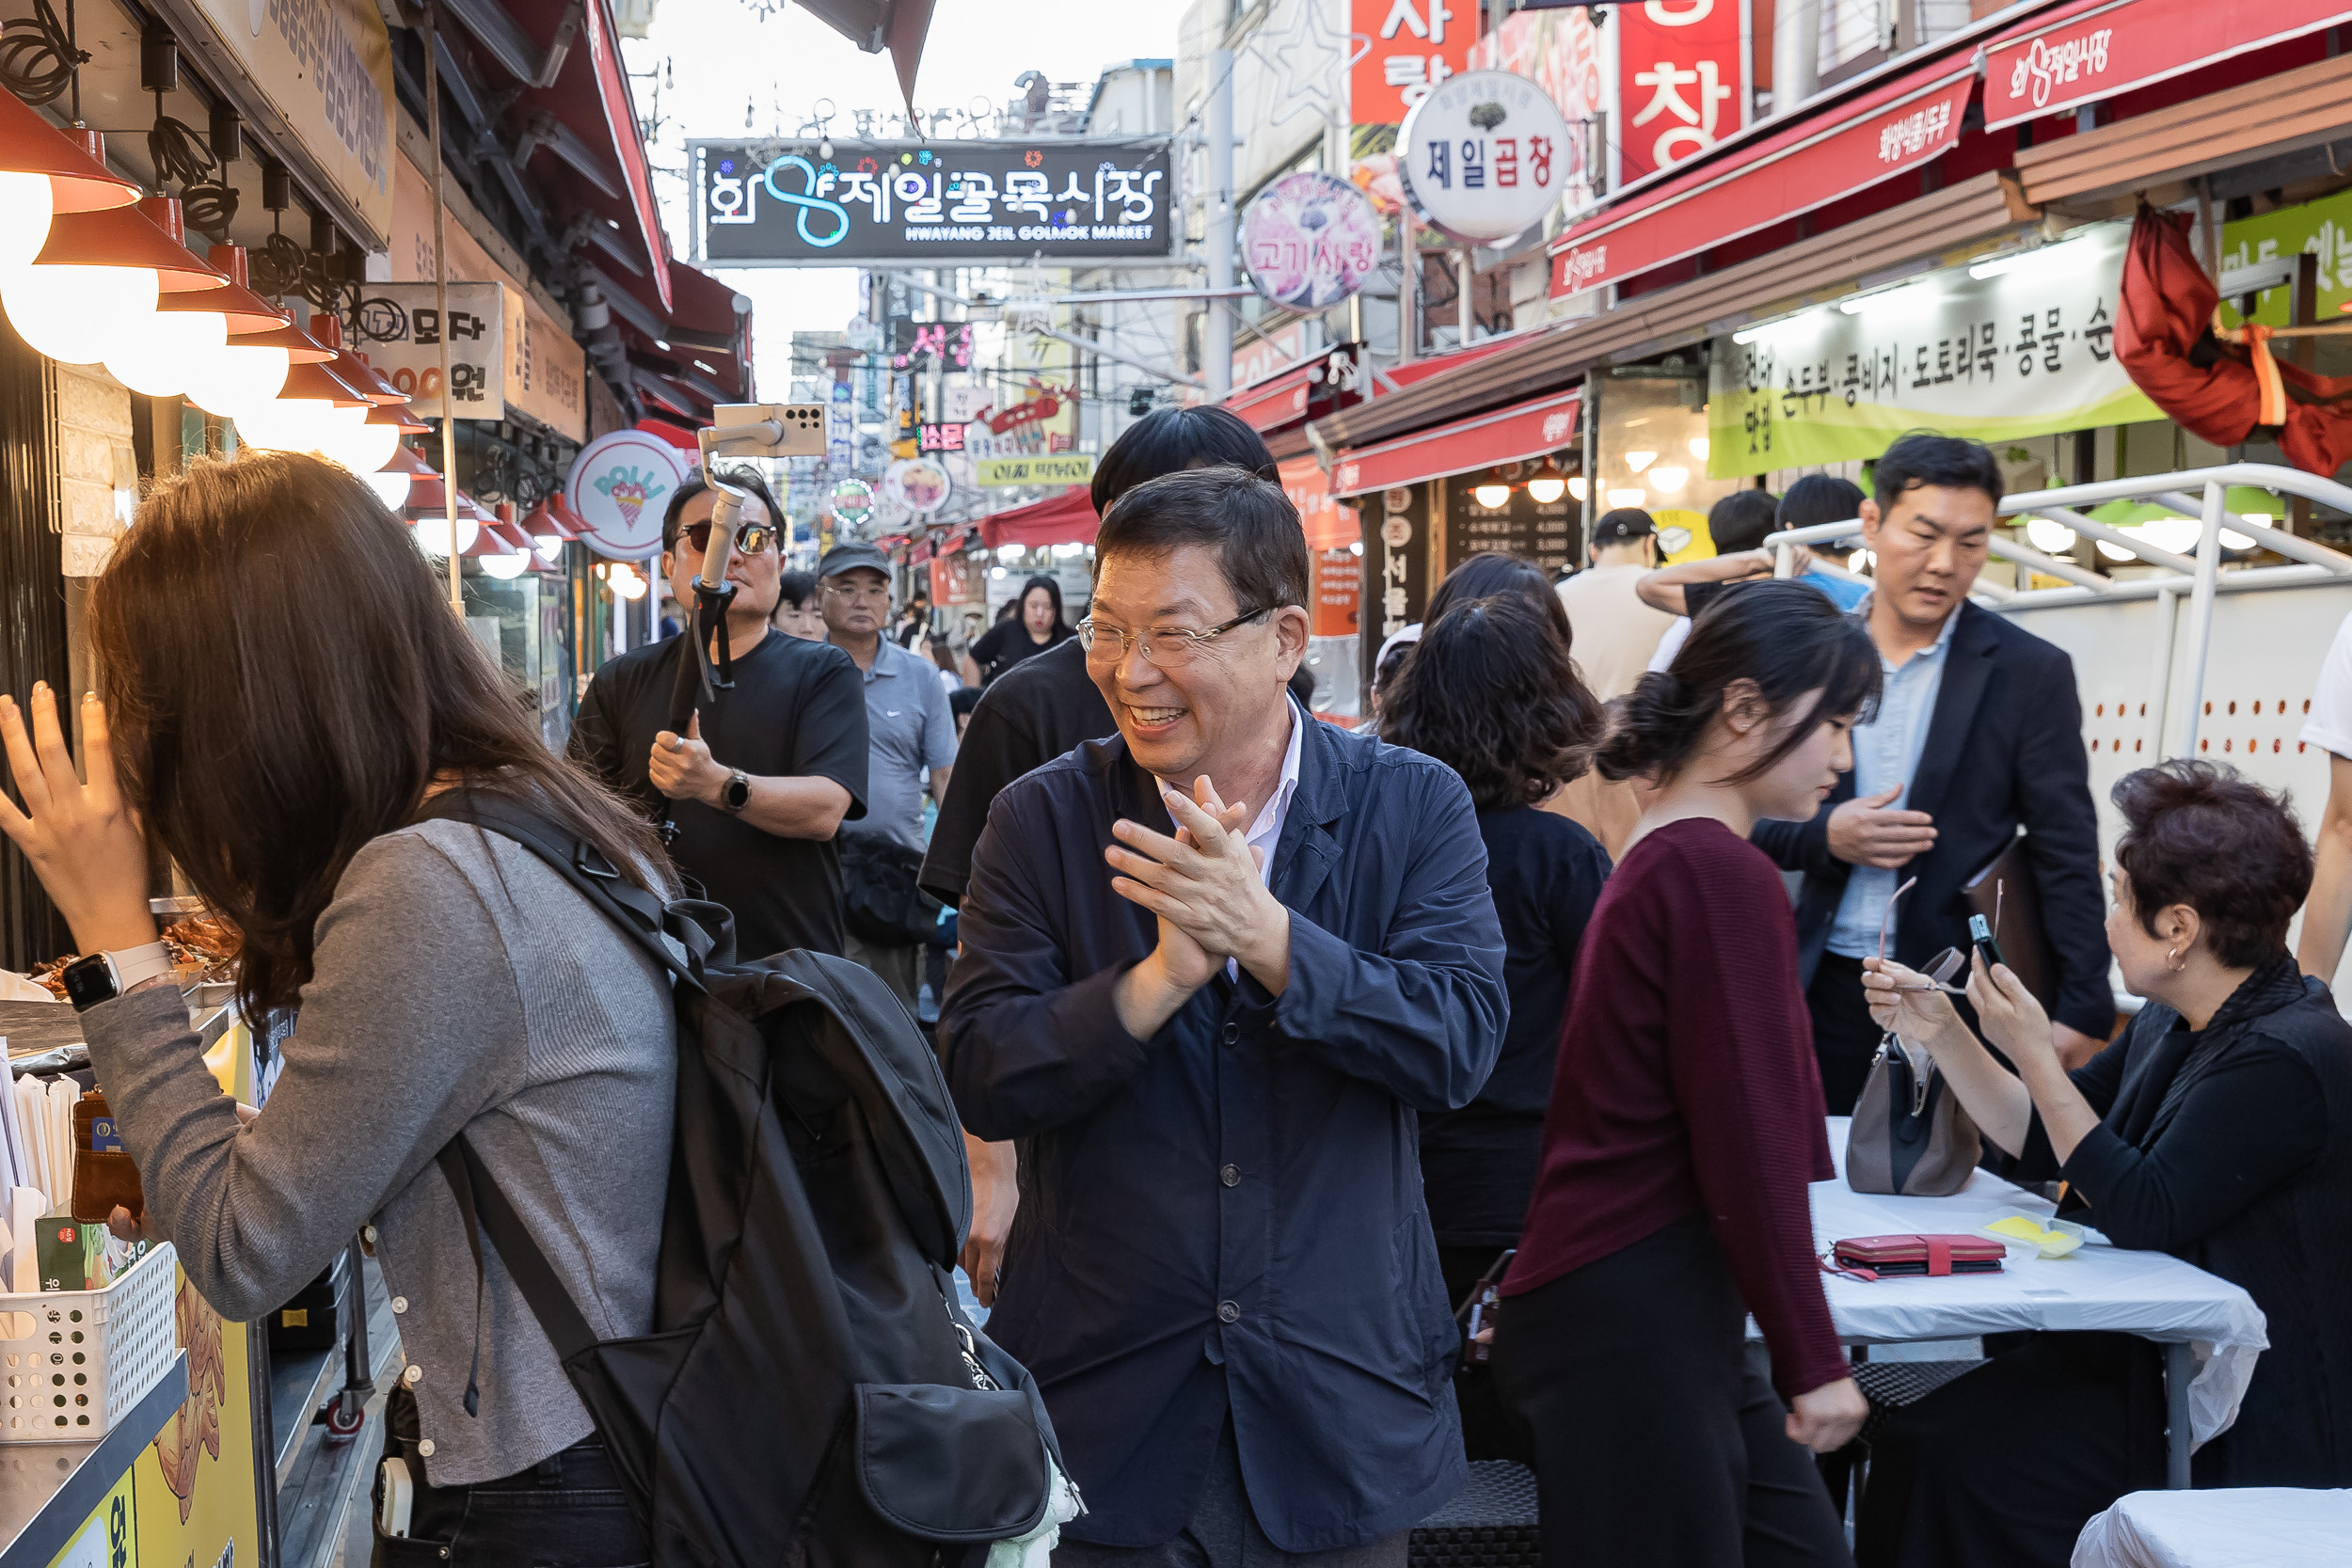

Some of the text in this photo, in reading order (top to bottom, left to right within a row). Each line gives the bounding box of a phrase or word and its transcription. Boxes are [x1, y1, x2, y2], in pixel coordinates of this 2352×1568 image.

[1427, 135, 1554, 189] 제일곱창
[904, 225, 1153, 242] HWAYANG JEIL GOLMOK MARKET
[1256, 241, 1374, 272] 고기사랑
